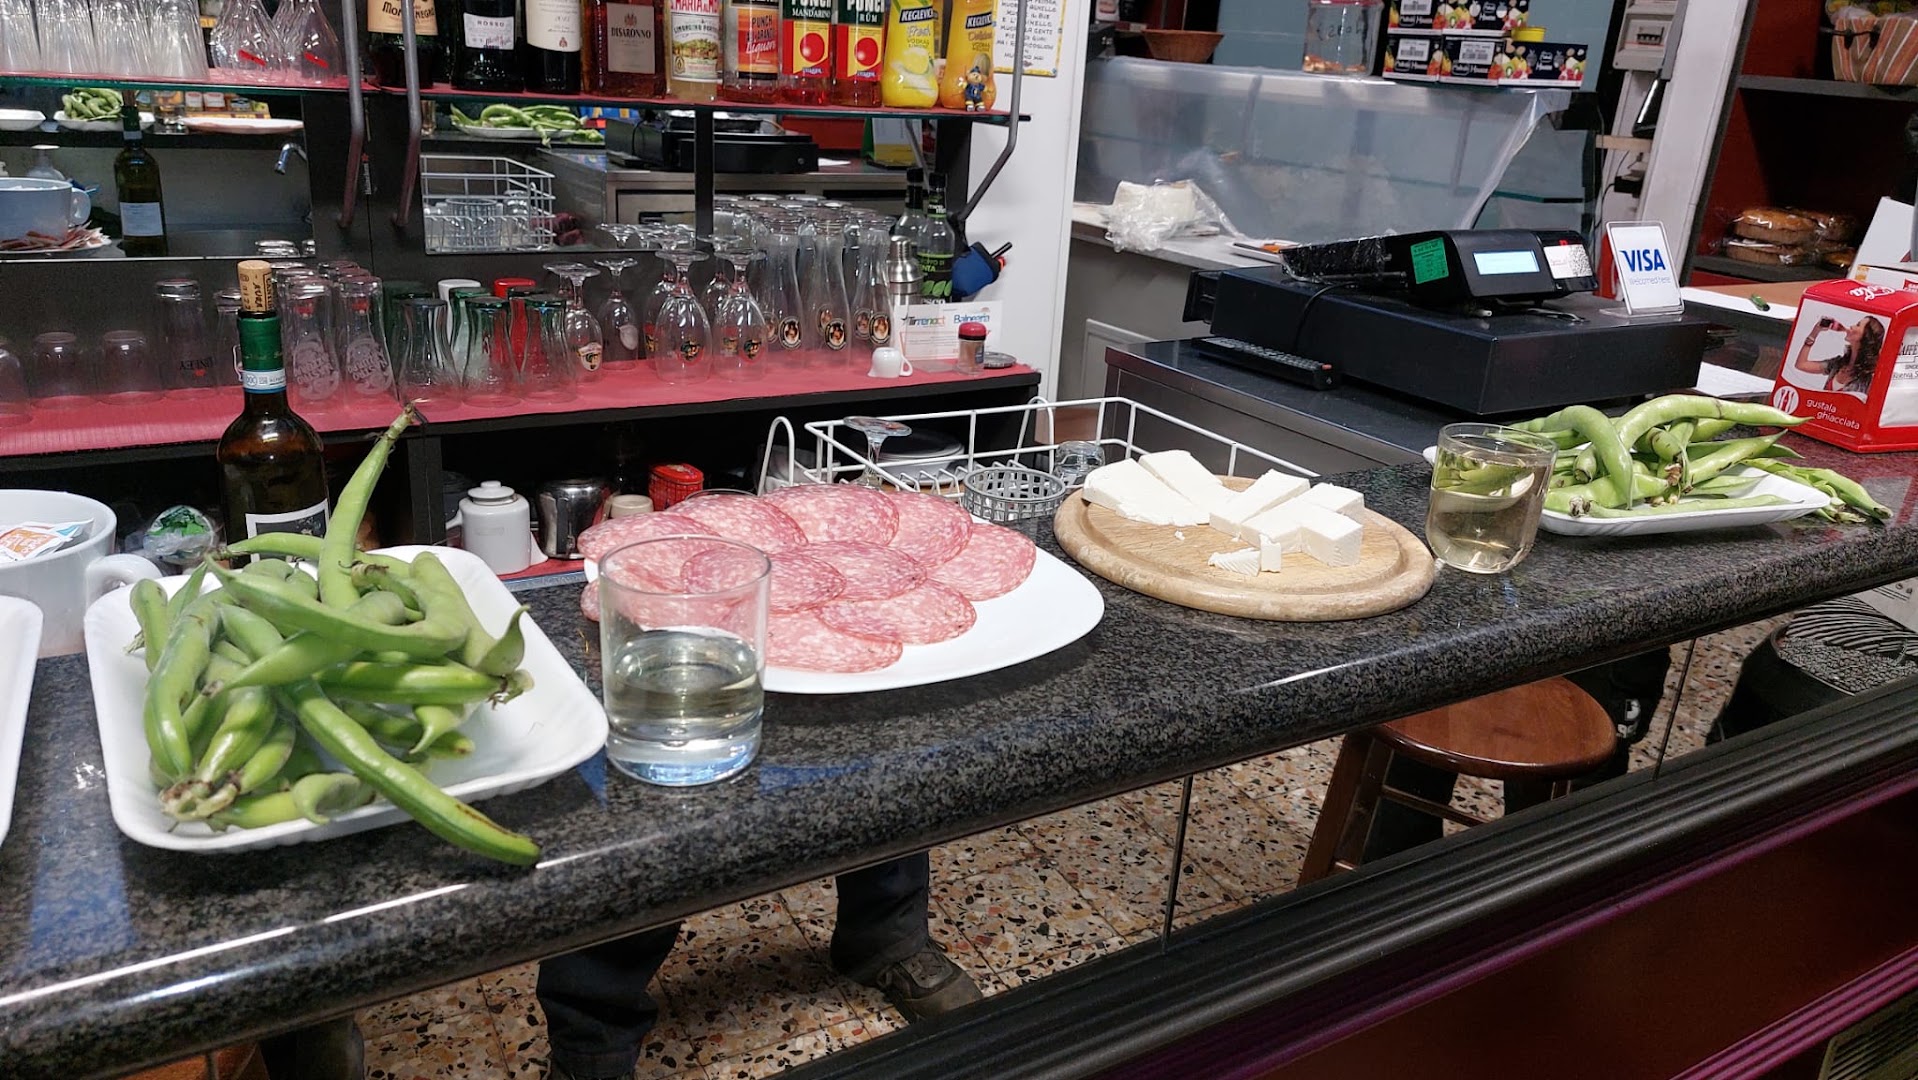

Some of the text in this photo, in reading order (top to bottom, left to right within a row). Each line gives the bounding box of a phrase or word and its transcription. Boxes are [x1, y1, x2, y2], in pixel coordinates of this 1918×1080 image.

[792, 8, 831, 18] MANDARINO
[752, 15, 773, 29] PUNCH
[611, 27, 651, 39] DISARONNO
[1619, 248, 1666, 272] VISA
[1806, 398, 1837, 413] gustala
[1816, 410, 1860, 430] ghiacciata
